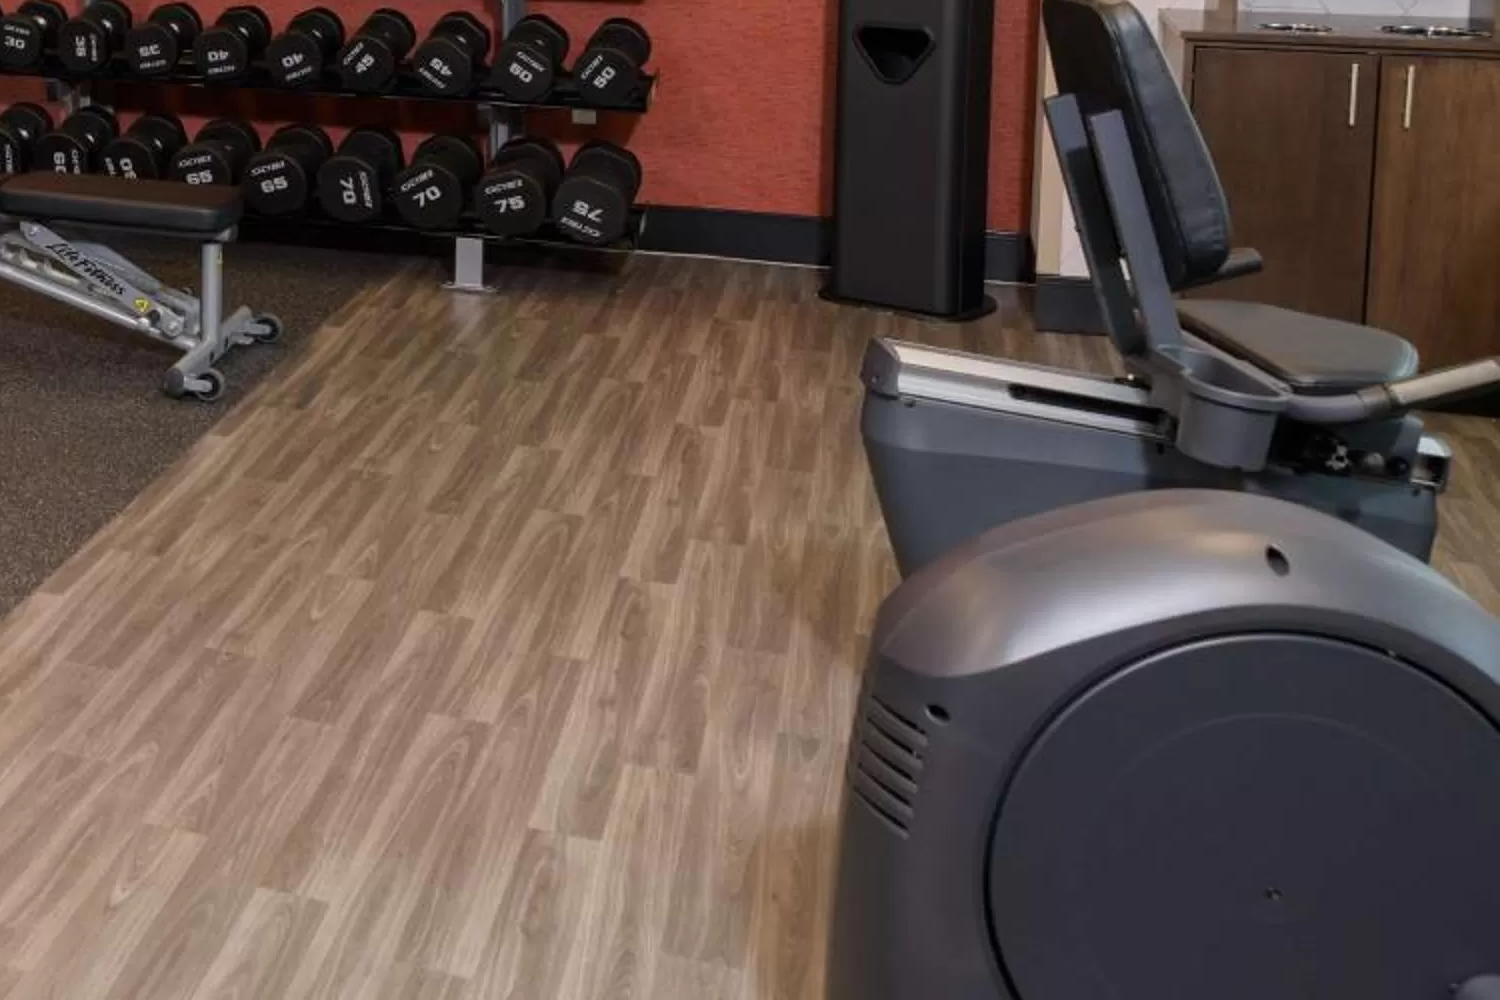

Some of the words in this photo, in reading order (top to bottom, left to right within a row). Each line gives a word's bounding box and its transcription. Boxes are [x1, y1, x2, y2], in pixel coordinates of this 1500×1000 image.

[3, 35, 26, 50] 30
[261, 176, 288, 193] 65
[340, 176, 357, 205] 70
[412, 185, 442, 208] 70
[494, 196, 525, 213] 75
[572, 200, 605, 223] 75
